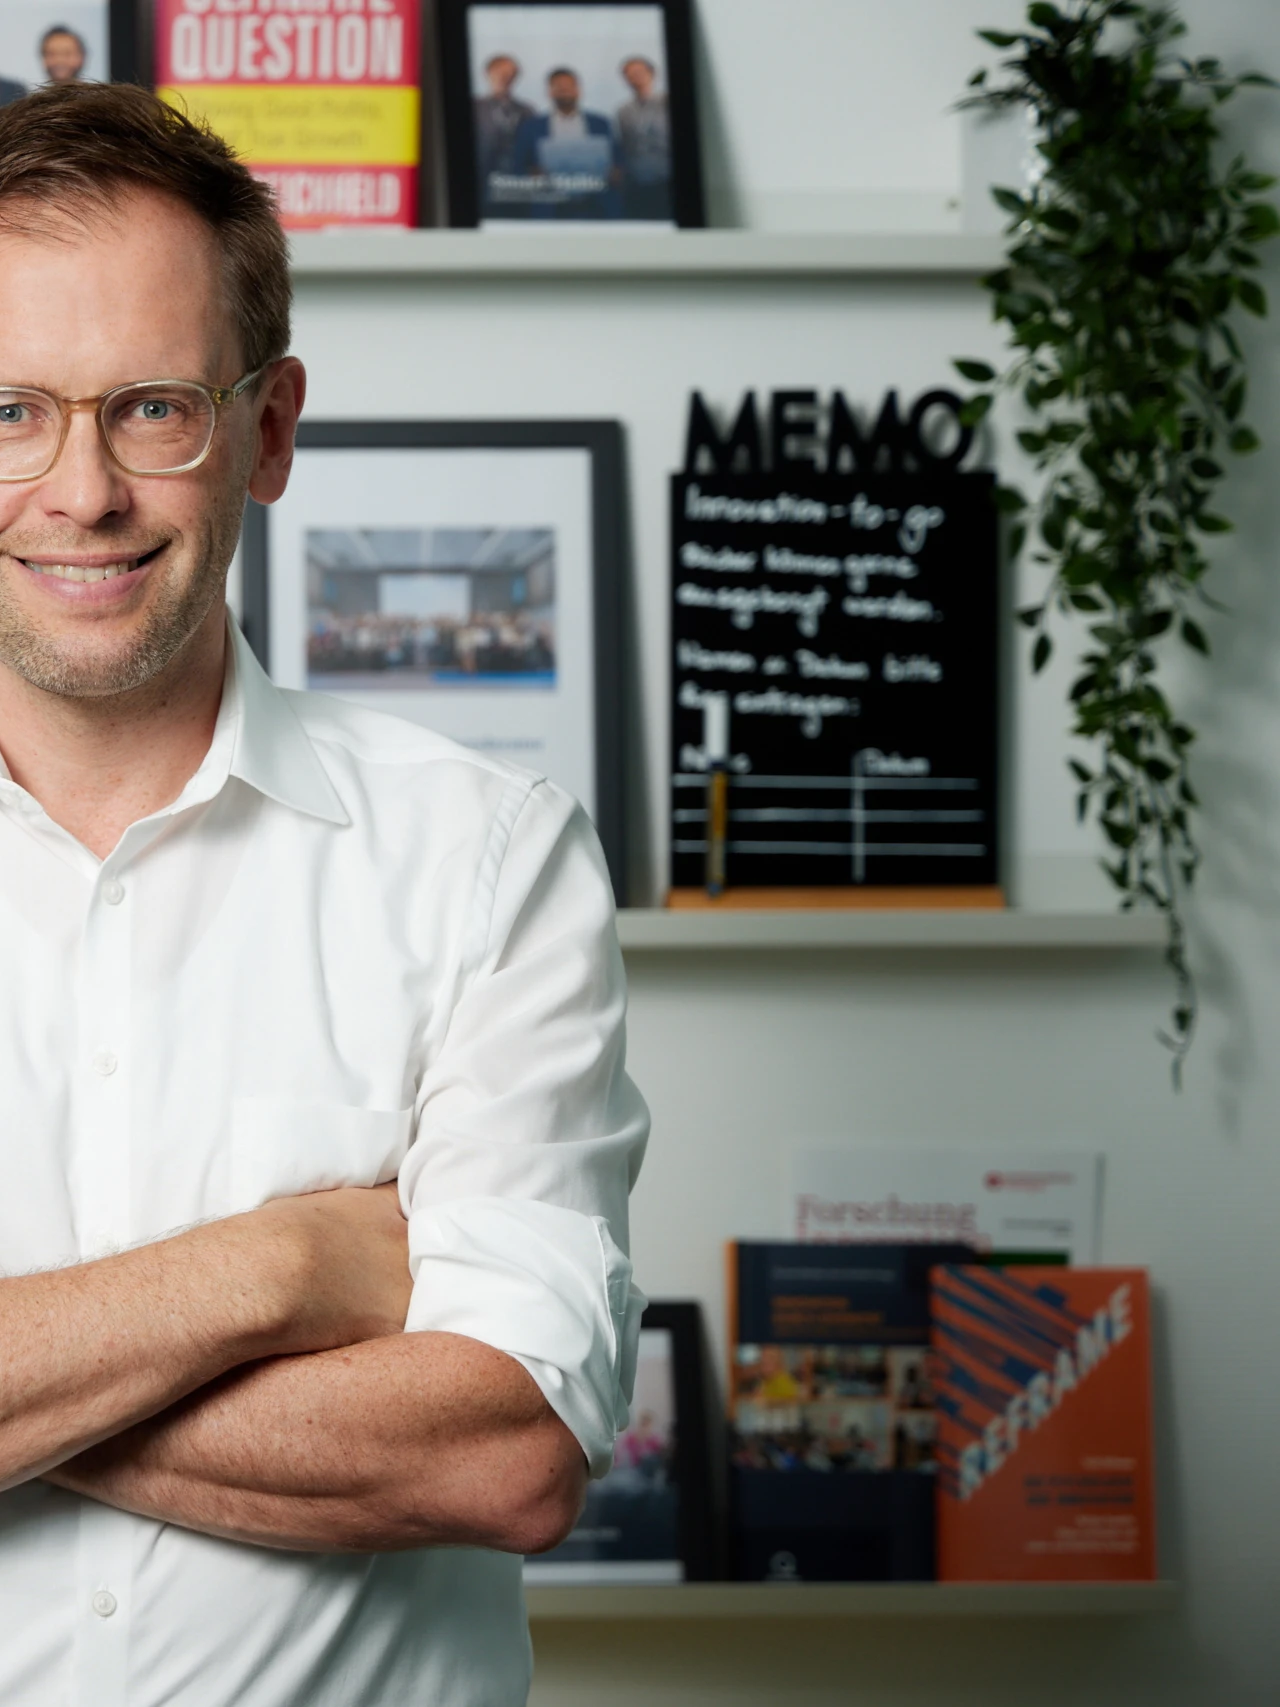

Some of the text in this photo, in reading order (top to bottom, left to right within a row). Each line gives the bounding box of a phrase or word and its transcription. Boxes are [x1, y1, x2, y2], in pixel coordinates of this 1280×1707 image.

[170, 13, 403, 81] QUESTION
[684, 389, 974, 474] MEMO
[794, 1192, 978, 1232] Forschung
[959, 1282, 1133, 1505] REFRAME
